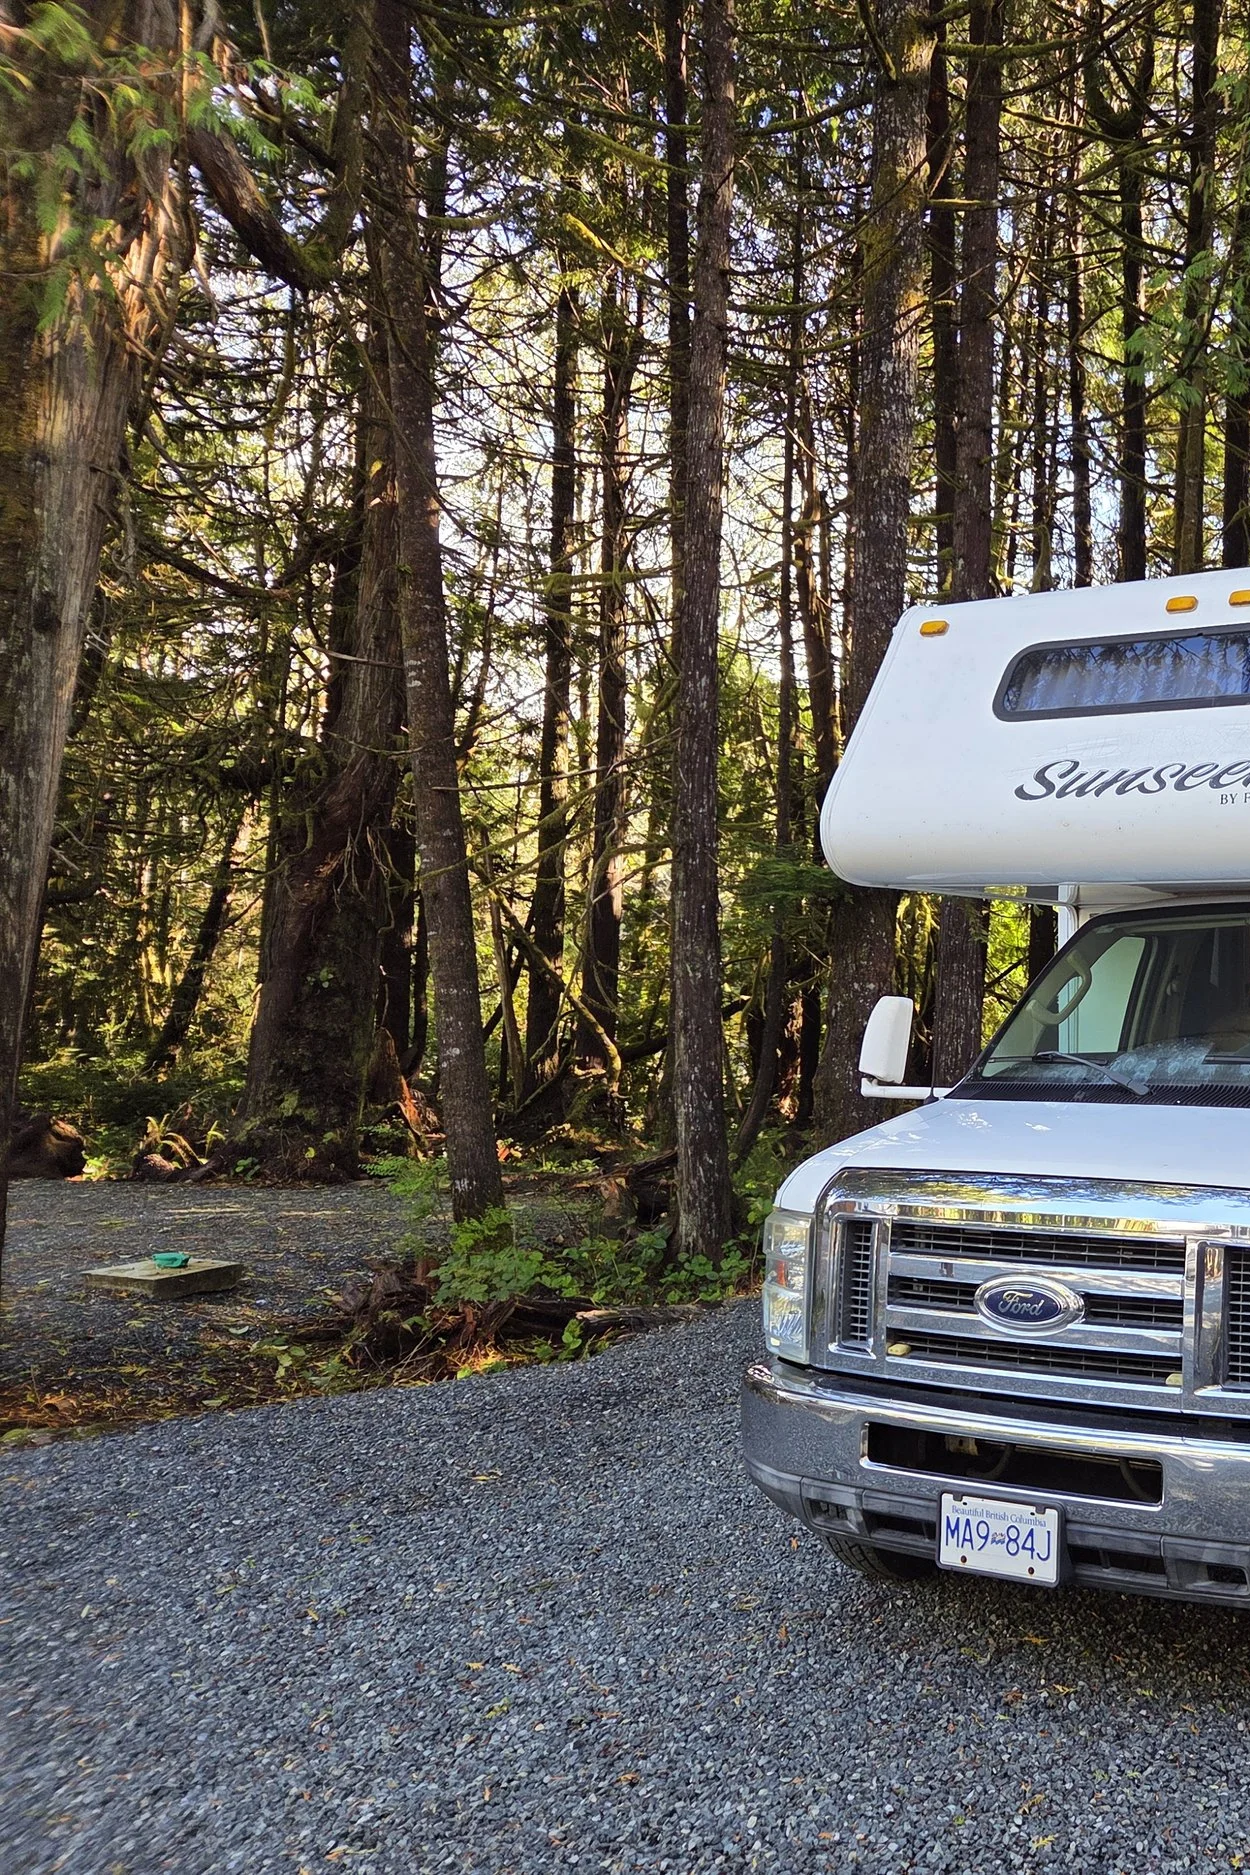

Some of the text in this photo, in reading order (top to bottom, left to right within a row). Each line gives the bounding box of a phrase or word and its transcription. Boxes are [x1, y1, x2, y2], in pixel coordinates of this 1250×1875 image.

[1220, 793, 1238, 805] BY
[997, 1290, 1044, 1316] Ford
[951, 1505, 1047, 1527] Beautiful British Columbia
[945, 1515, 1051, 1561] MA9 84J
